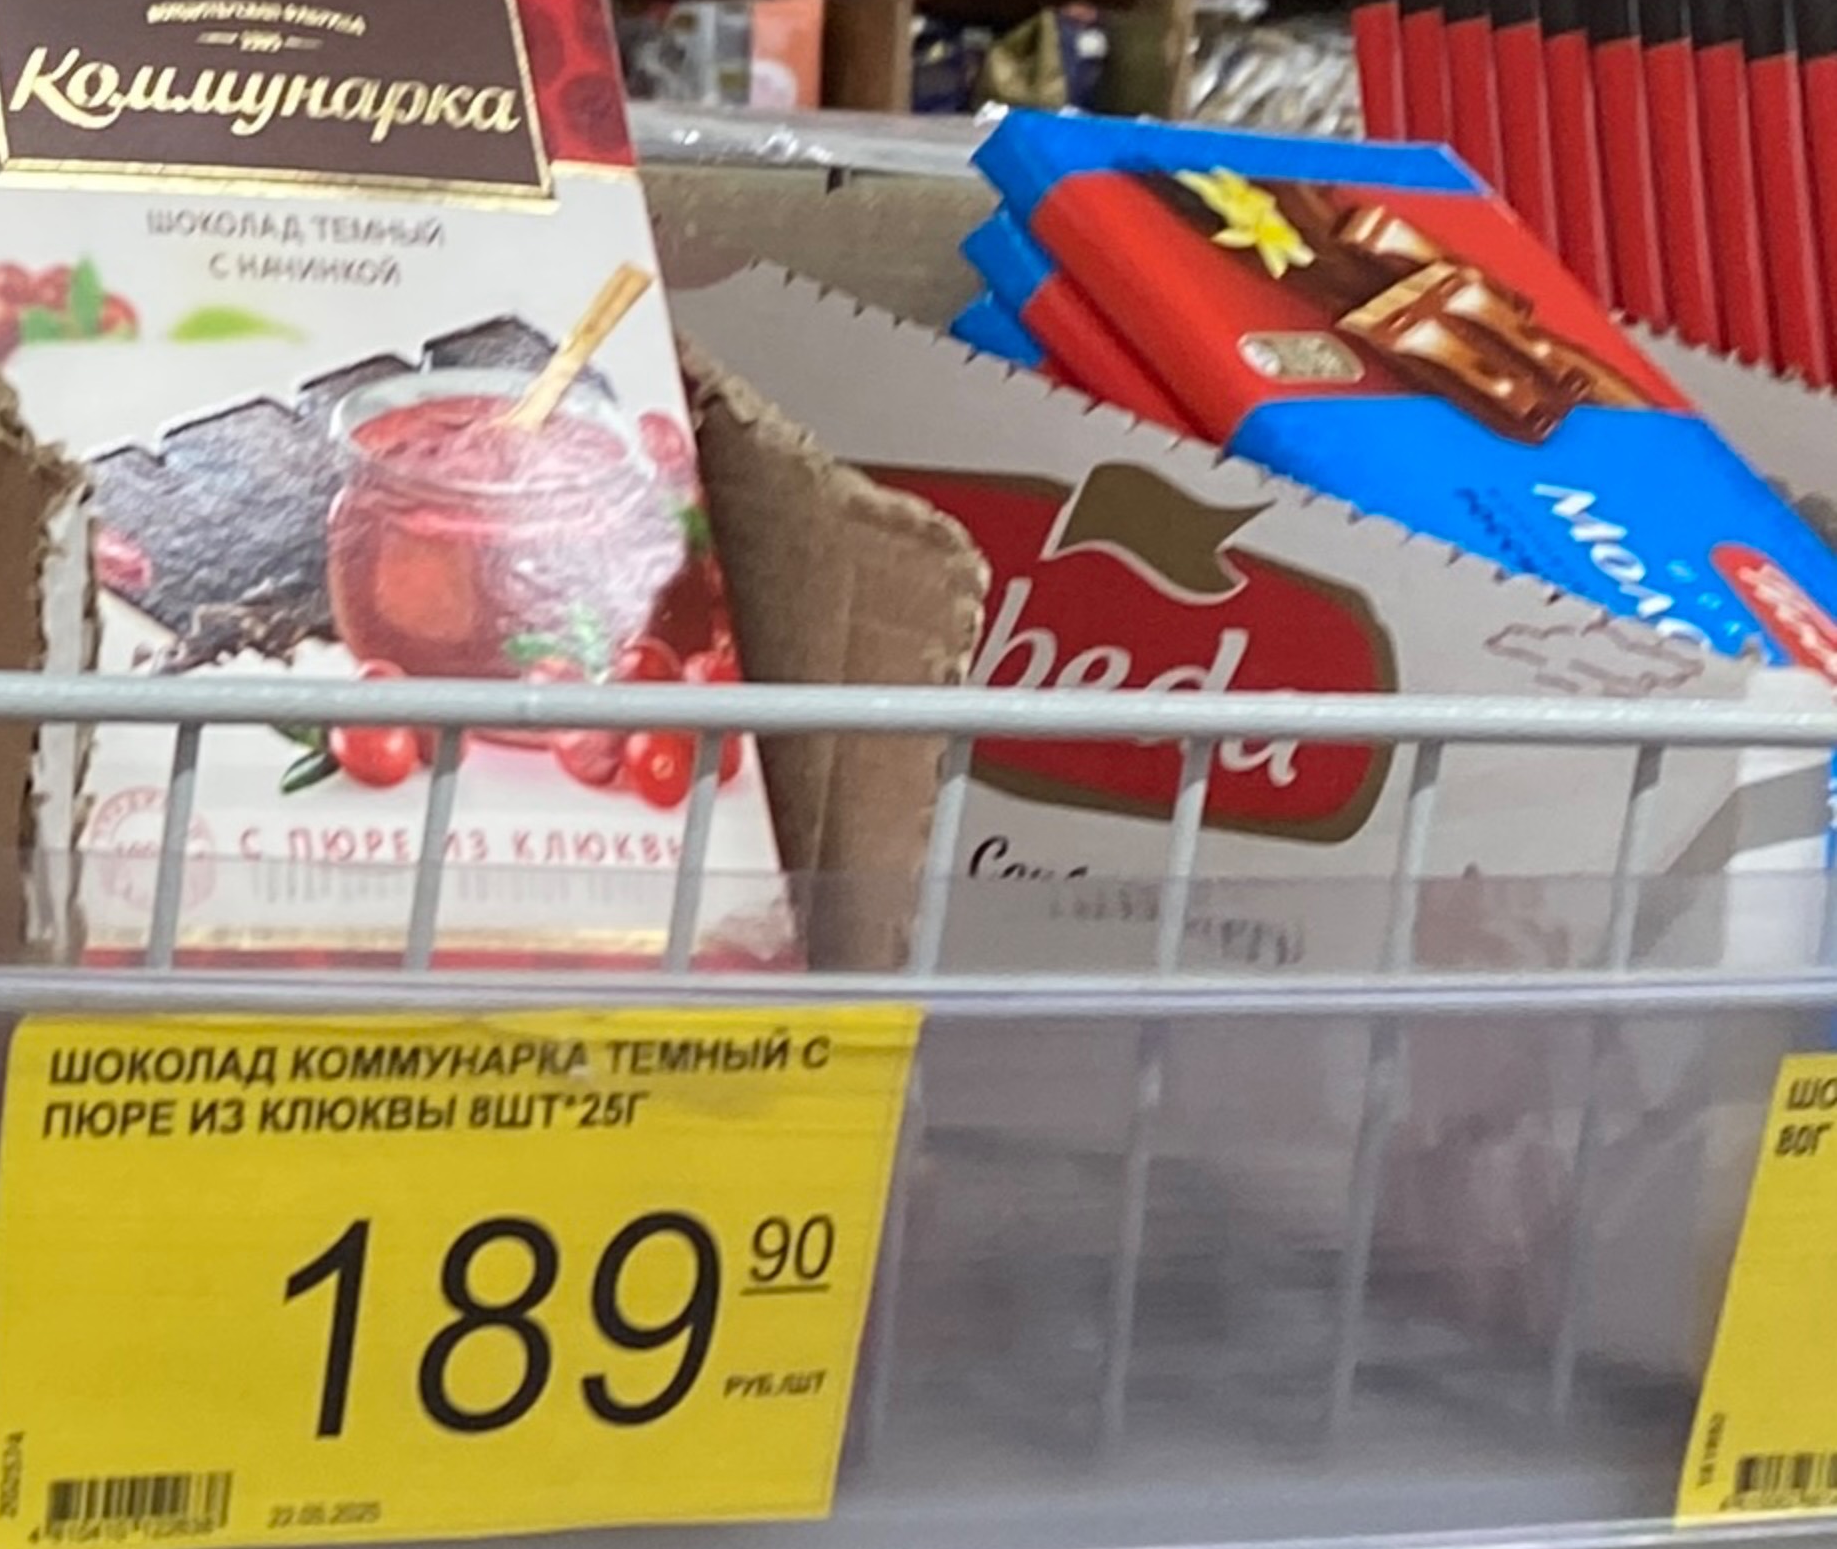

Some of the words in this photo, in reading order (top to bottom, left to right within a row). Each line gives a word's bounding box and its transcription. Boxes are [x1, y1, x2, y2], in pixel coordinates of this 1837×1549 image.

[9, 46, 523, 143] Коммунарка
[146, 207, 307, 246] ШОКОЛАД
[49, 1044, 276, 1088] ШОКОЛАД
[289, 1038, 590, 1083] КОММУНАРКА
[605, 1025, 792, 1076] ТЕМНЫЙ
[801, 1035, 832, 1070] С
[41, 1098, 175, 1140] ПЮРЕ
[189, 1100, 246, 1135] ИЗ
[258, 1095, 457, 1135] КЛЮКВЫ
[751, 1213, 837, 1284] 90
[283, 1207, 725, 1442] 189
